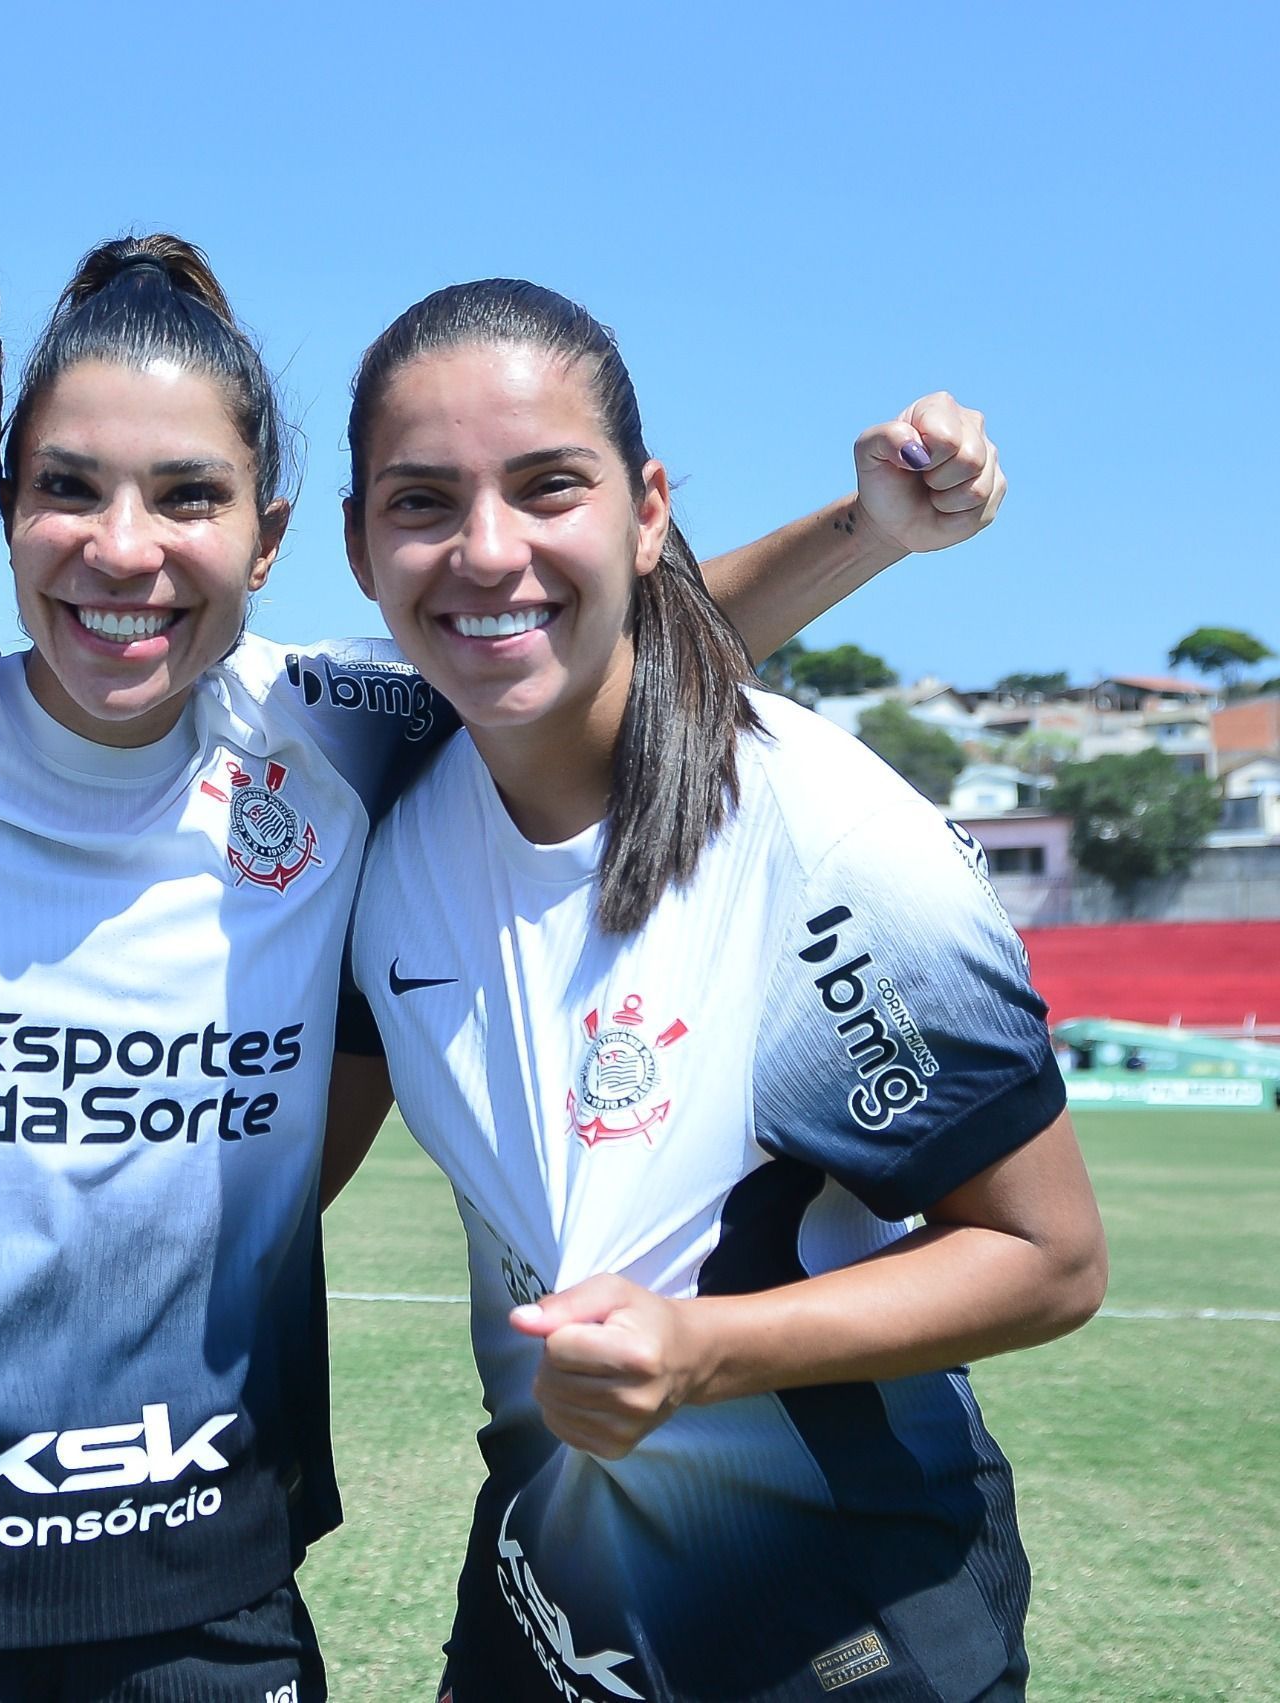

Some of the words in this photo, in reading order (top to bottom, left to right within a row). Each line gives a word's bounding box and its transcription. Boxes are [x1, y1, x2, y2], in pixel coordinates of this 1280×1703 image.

[324, 659, 434, 741] bmg
[339, 663, 419, 675] CORINTHIAN
[813, 951, 928, 1130] bmg
[877, 977, 939, 1077] CORINTHIANS
[79, 1086, 280, 1144] Sorte
[497, 1564, 594, 1703] Consór
